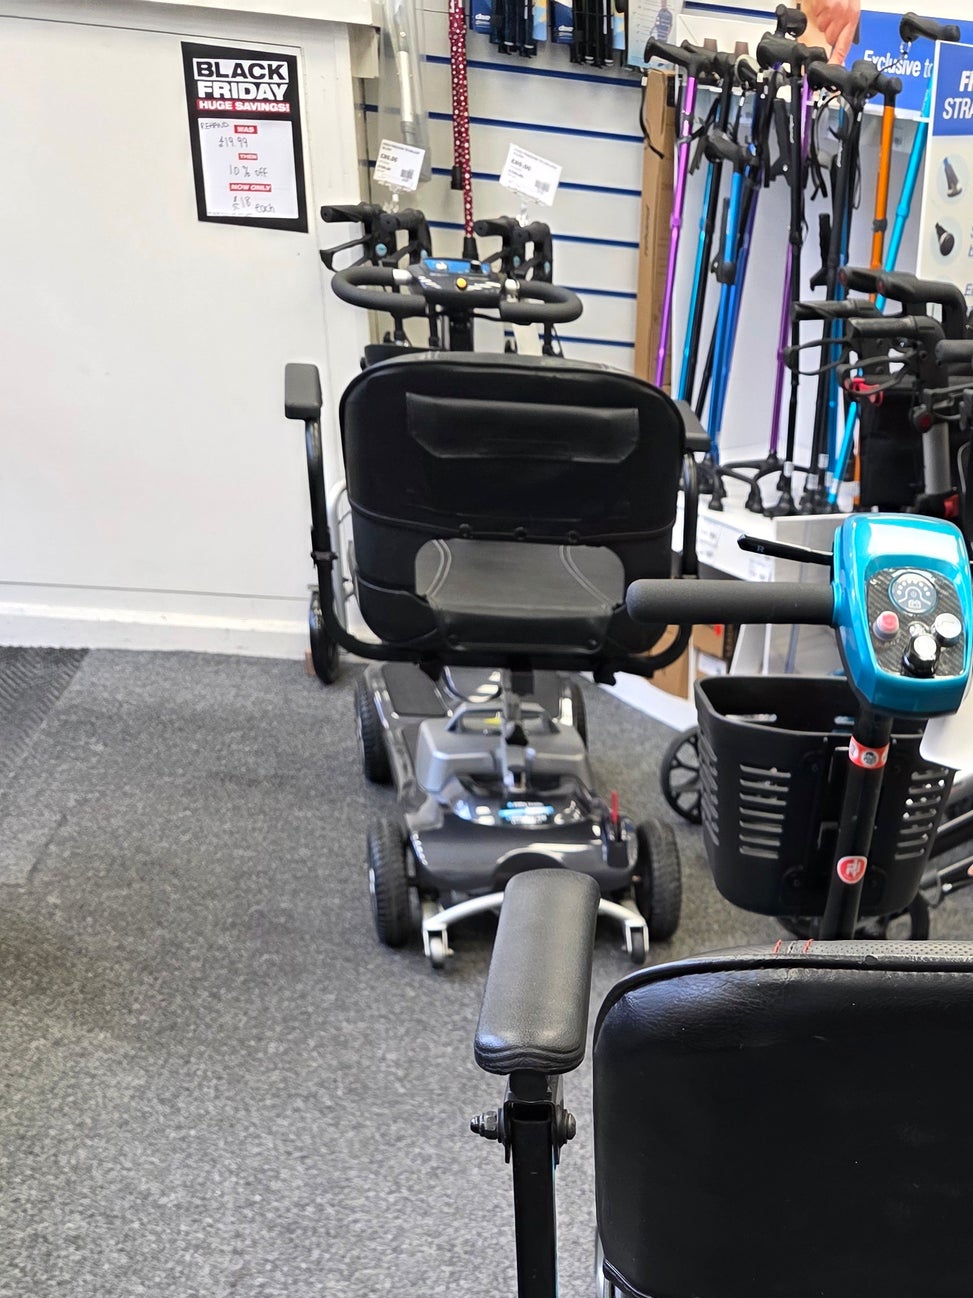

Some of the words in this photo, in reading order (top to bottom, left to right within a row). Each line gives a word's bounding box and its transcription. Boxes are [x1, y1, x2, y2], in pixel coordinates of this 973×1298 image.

[195, 61, 286, 80] BLACK
[864, 50, 921, 78] Exclusive
[197, 81, 288, 101] FRIDAY
[198, 100, 233, 110] HUGE
[234, 101, 290, 112] SAVINGS!
